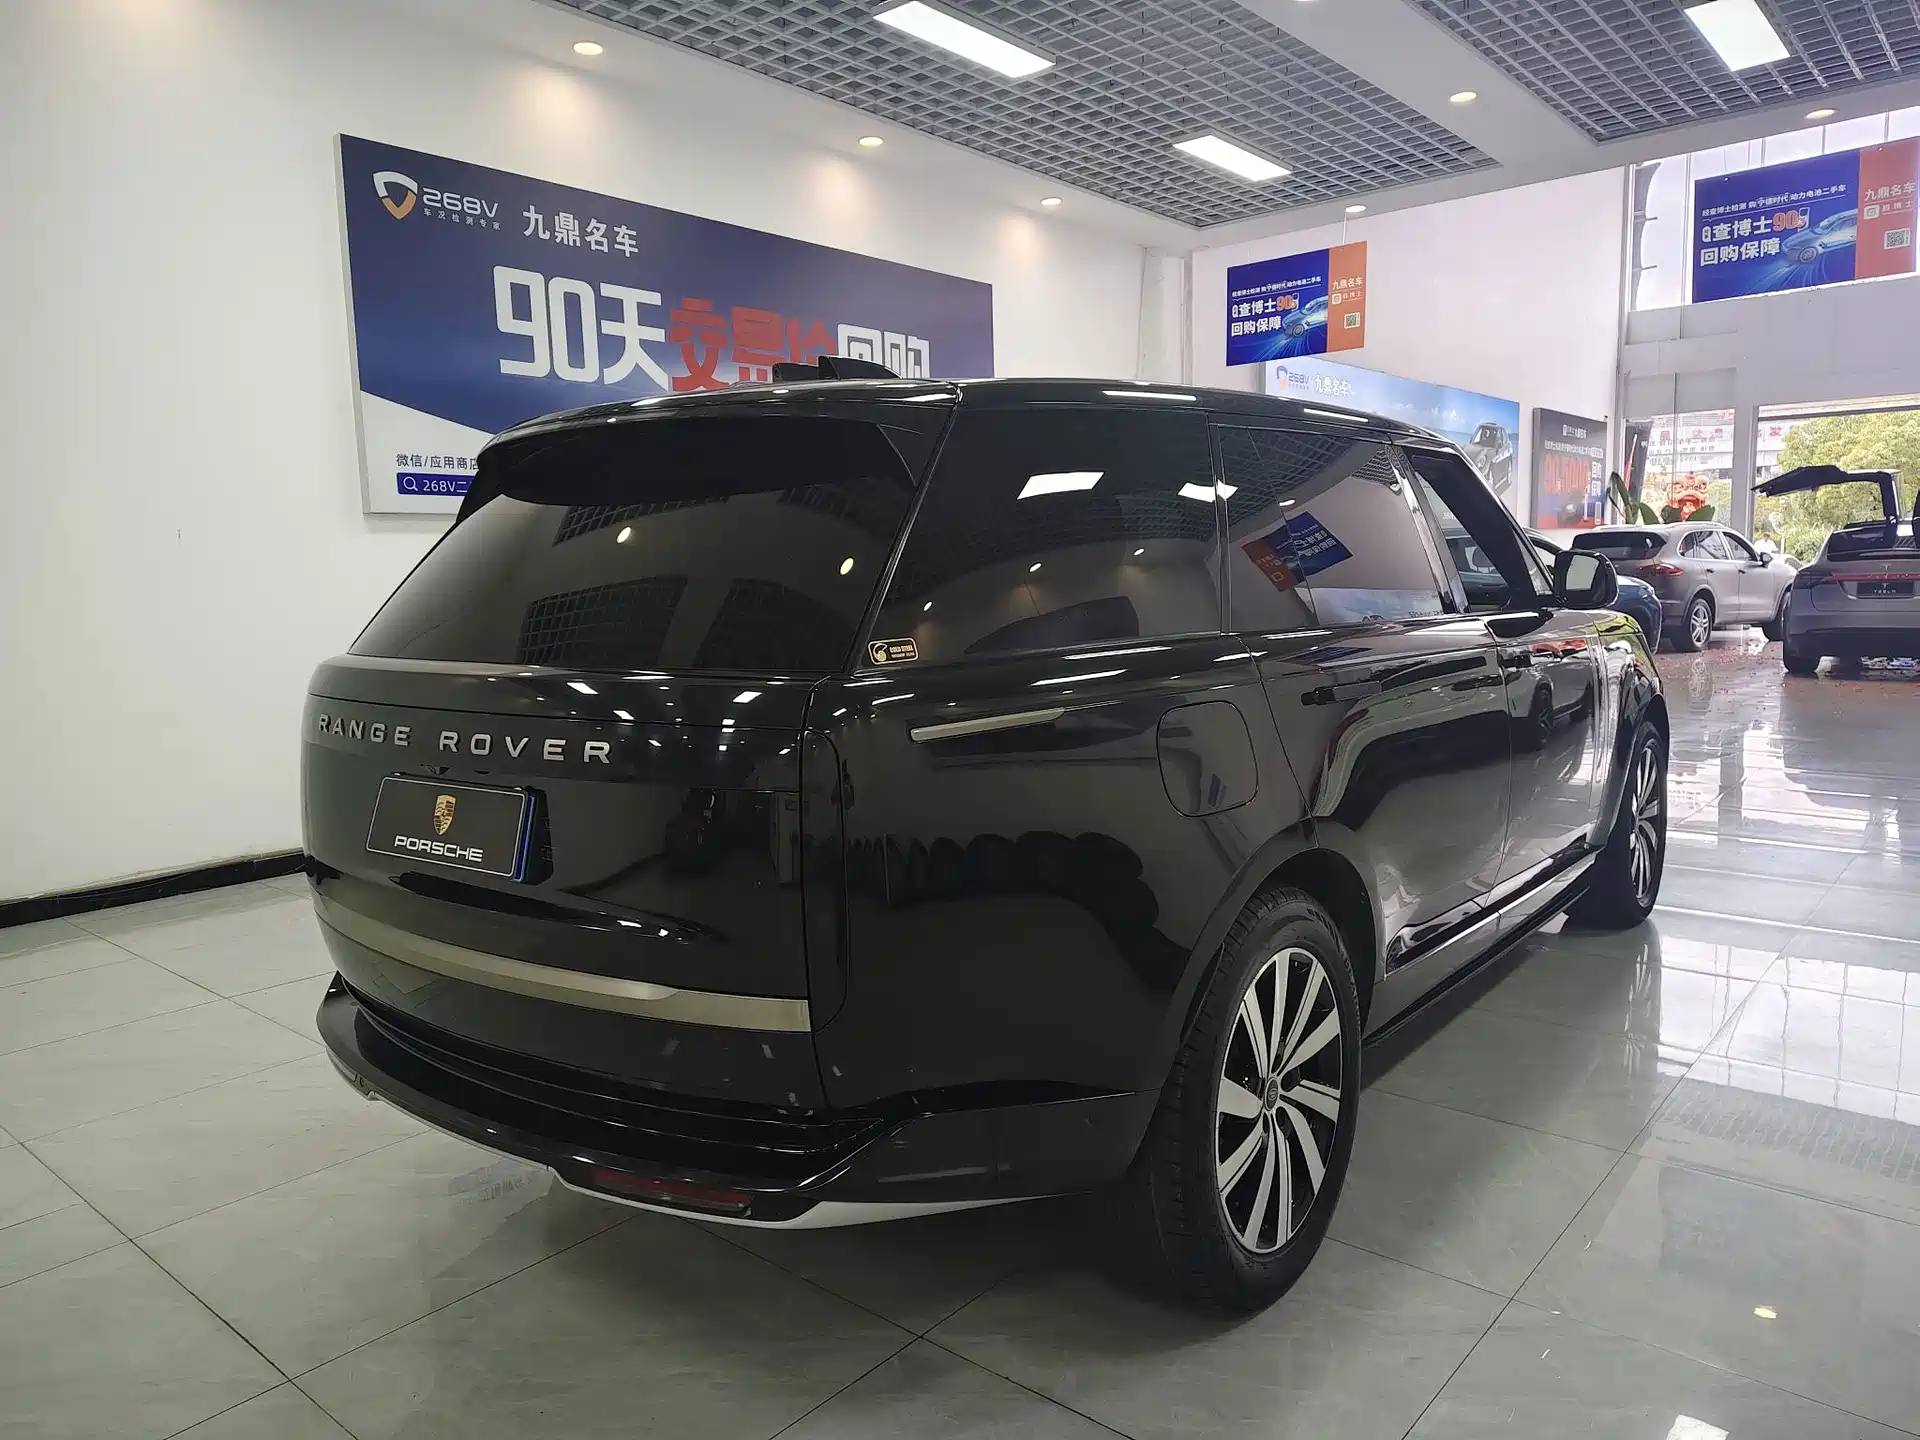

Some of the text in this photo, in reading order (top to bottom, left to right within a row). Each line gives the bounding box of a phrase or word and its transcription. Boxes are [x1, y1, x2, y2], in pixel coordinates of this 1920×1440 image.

[423, 187, 499, 218] 268V
[1865, 182, 1916, 201] 九鼎名车
[423, 207, 501, 231] 车况检测专家
[522, 204, 639, 257] 九鼎名车
[1700, 238, 1781, 266] 回购保障
[1231, 316, 1281, 336] 回购保障
[423, 480, 473, 492] 268V二
[318, 714, 611, 764] RANGE ROVER
[394, 835, 484, 863] PORSCHE
